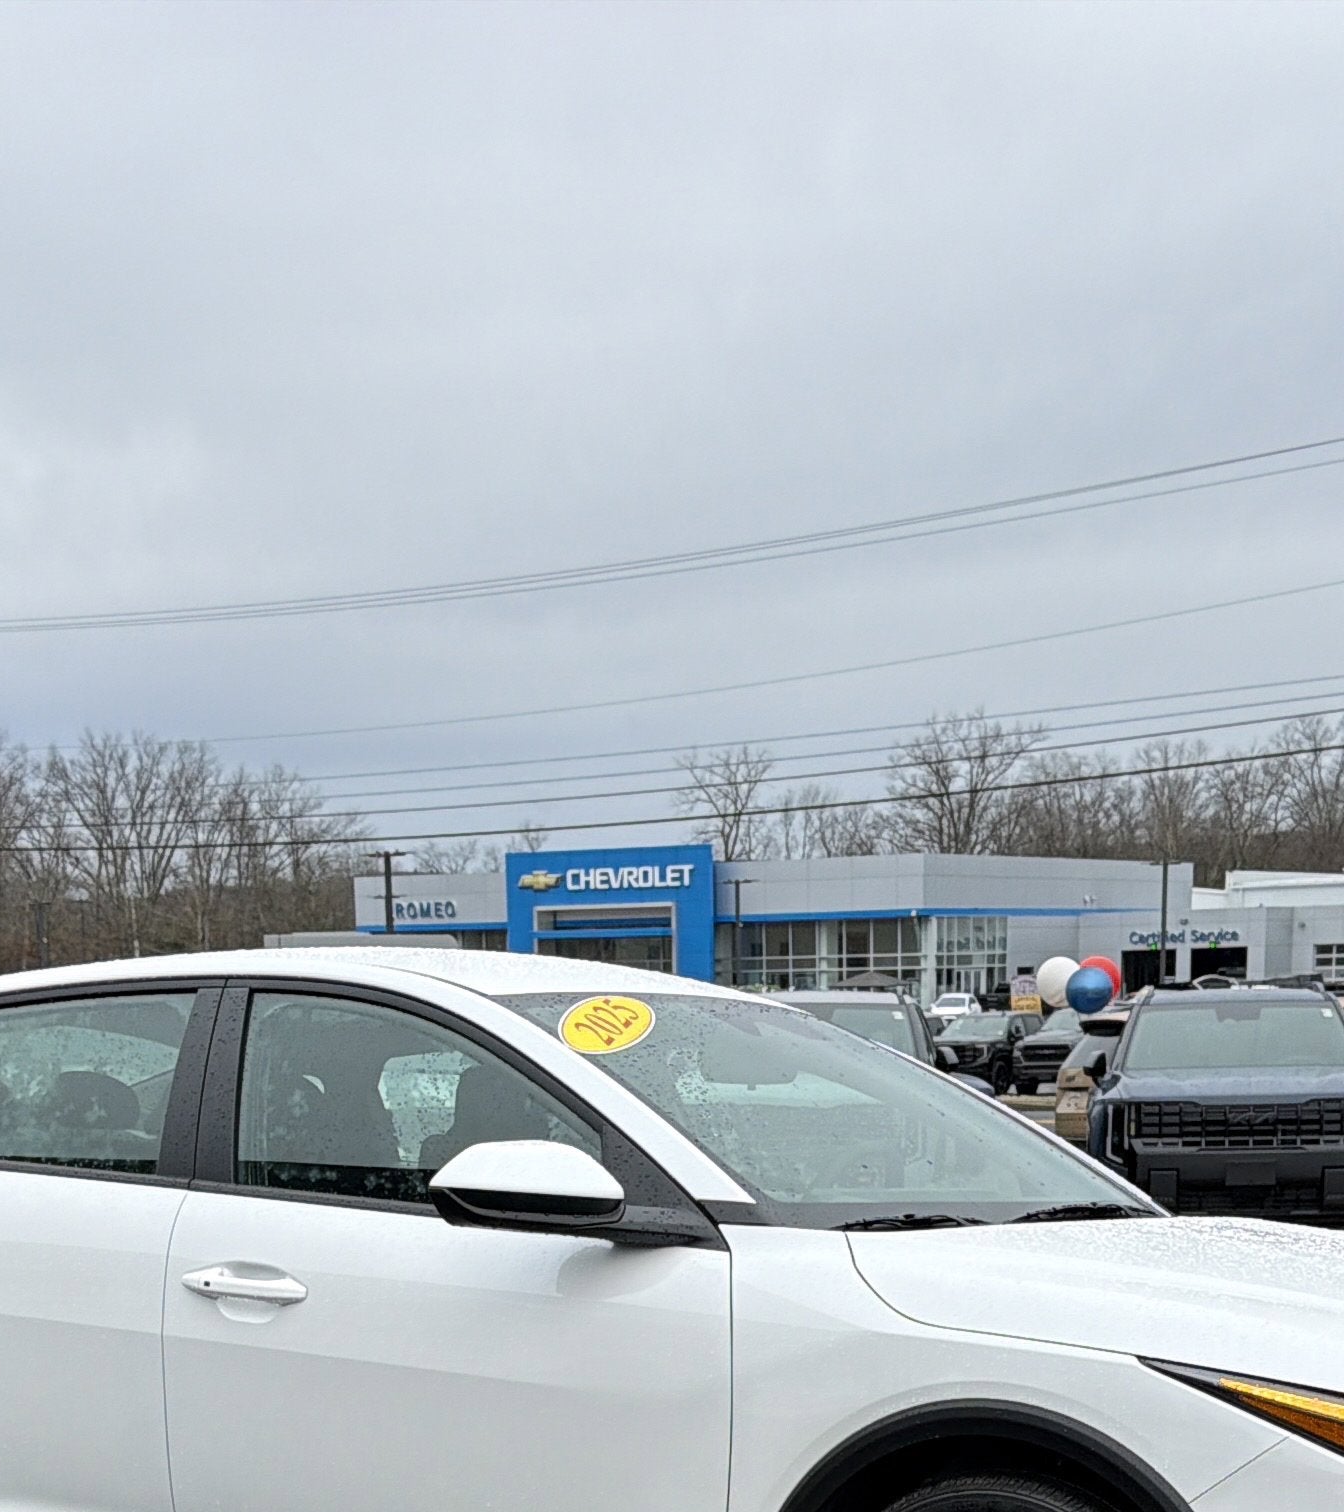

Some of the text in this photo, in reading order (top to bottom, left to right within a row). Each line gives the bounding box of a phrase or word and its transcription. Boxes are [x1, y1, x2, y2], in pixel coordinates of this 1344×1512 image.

[566, 864, 694, 891] CHEVROLET
[395, 901, 456, 919] ROMEO
[1191, 928, 1239, 944] Service
[574, 998, 639, 1046] 2025
